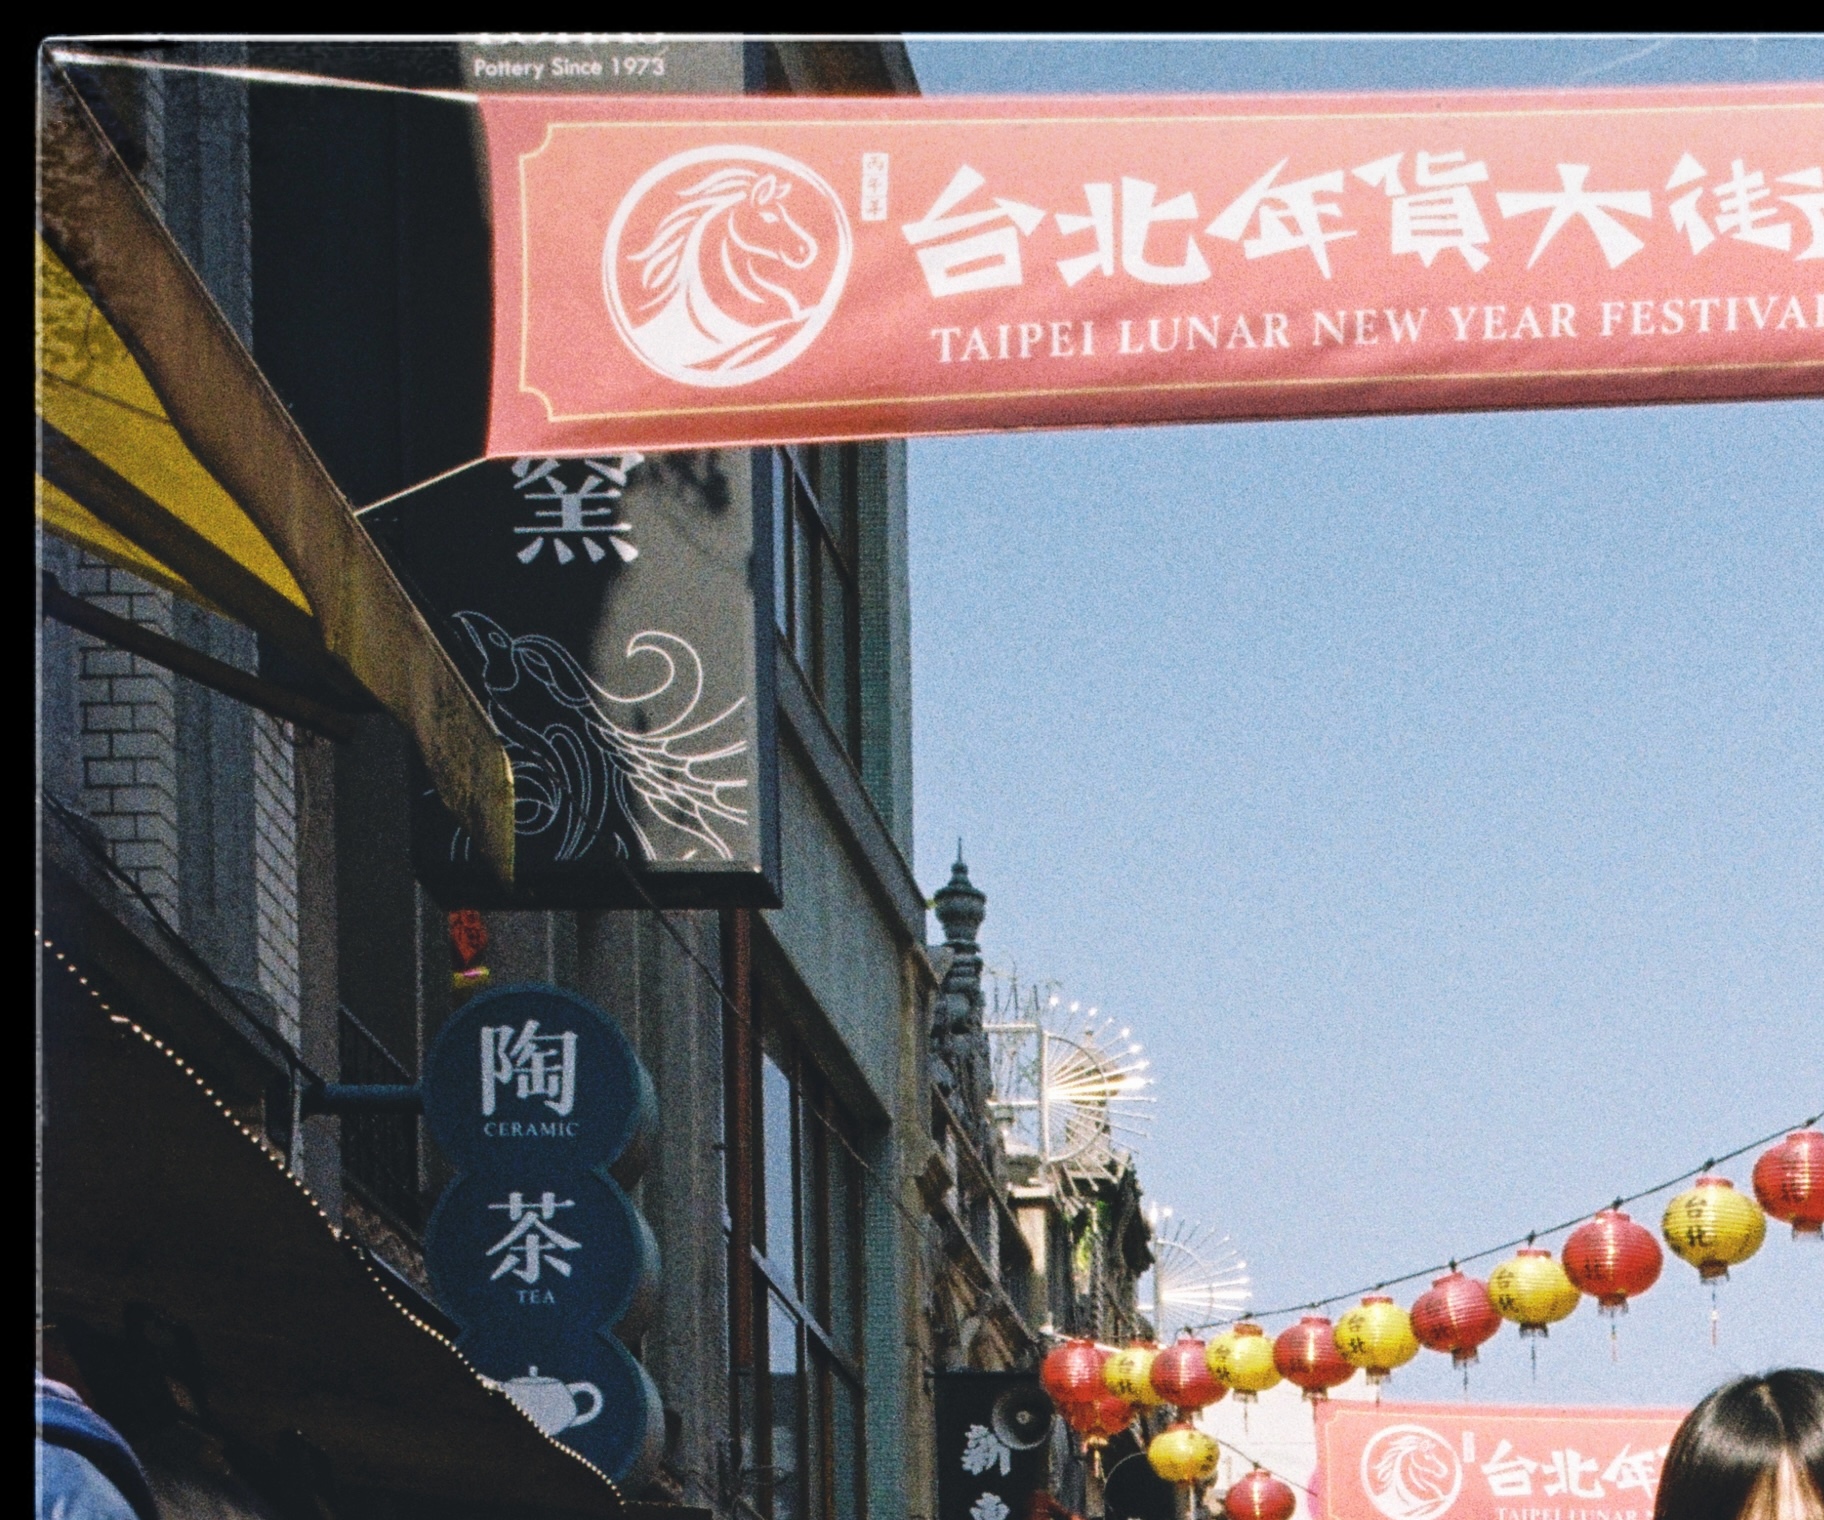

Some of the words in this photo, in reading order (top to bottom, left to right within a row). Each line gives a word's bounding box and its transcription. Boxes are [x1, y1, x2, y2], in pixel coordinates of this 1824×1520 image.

[474, 57, 545, 80] Pottery
[552, 56, 602, 76] Since
[612, 56, 666, 76] 1973
[932, 319, 1095, 363] TAIPEI
[1117, 311, 1291, 354] LUNAR
[1312, 306, 1429, 348] NEW
[1446, 301, 1578, 343] YEAR
[480, 1018, 578, 1116] 陶
[483, 1121, 580, 1138] CERAMIC
[486, 1192, 583, 1284] 茶
[1685, 1197, 1714, 1247] 台北
[516, 1289, 555, 1305] TEA
[1482, 1439, 1670, 1499] 台北年
